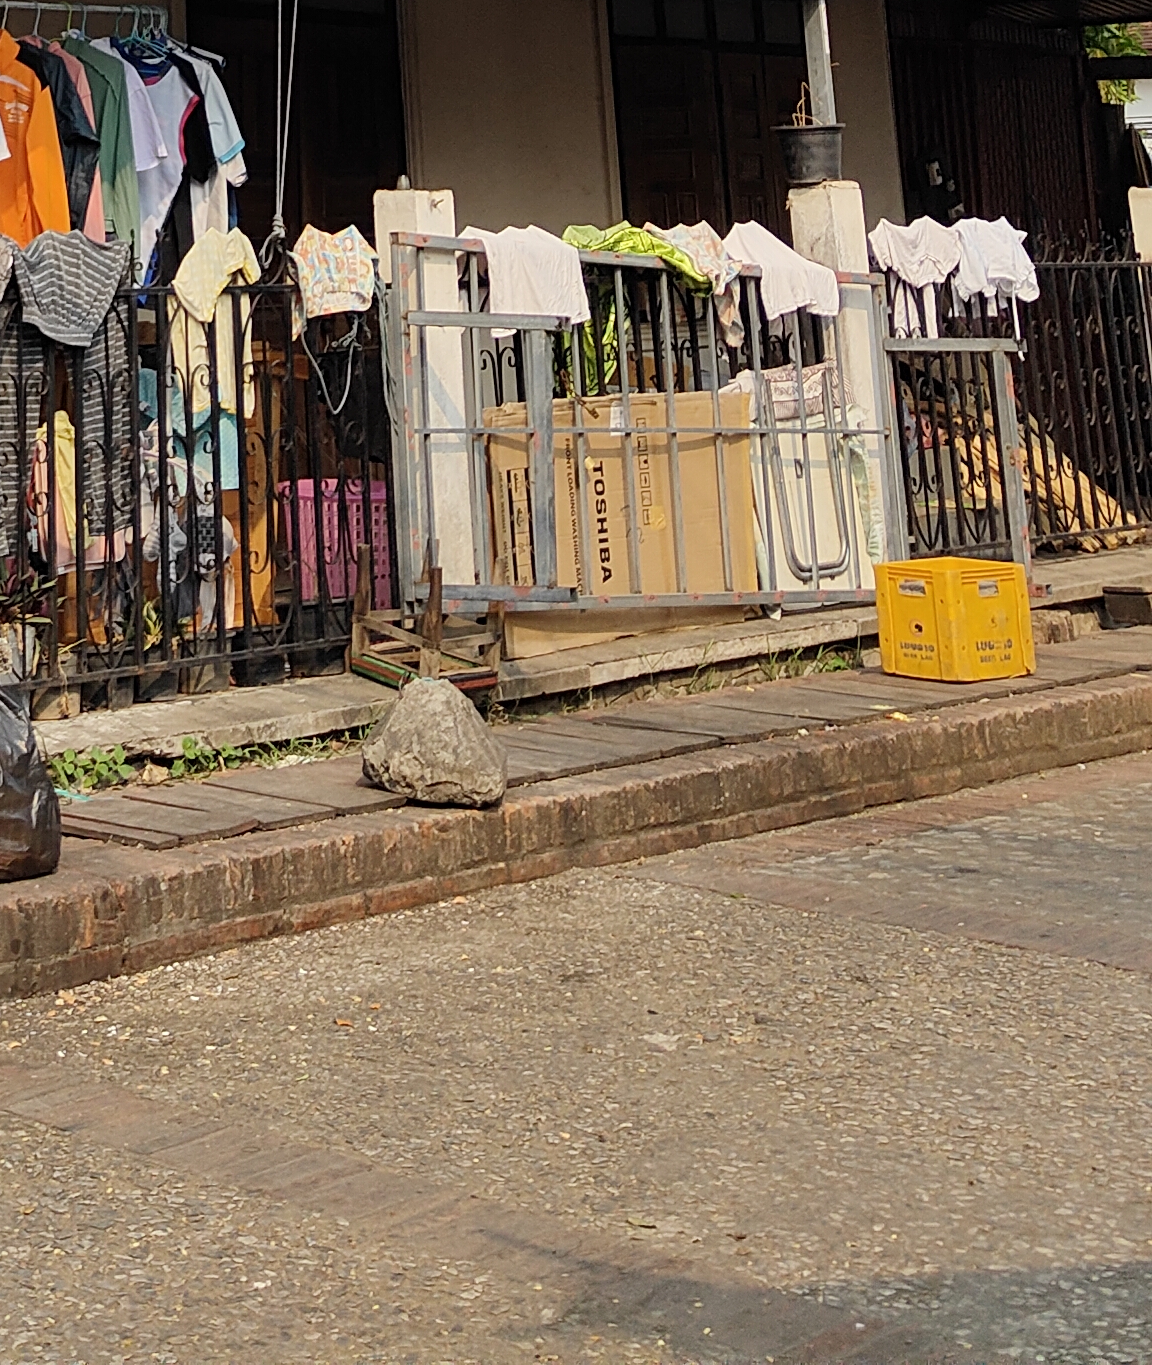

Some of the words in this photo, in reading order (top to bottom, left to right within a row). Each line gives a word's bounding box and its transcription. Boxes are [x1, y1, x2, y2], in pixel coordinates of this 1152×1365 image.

[564, 437, 572, 469] FRONT
[567, 472, 577, 517] LOADING
[570, 518, 580, 566] WASHING
[592, 460, 613, 584] TOSHIBA
